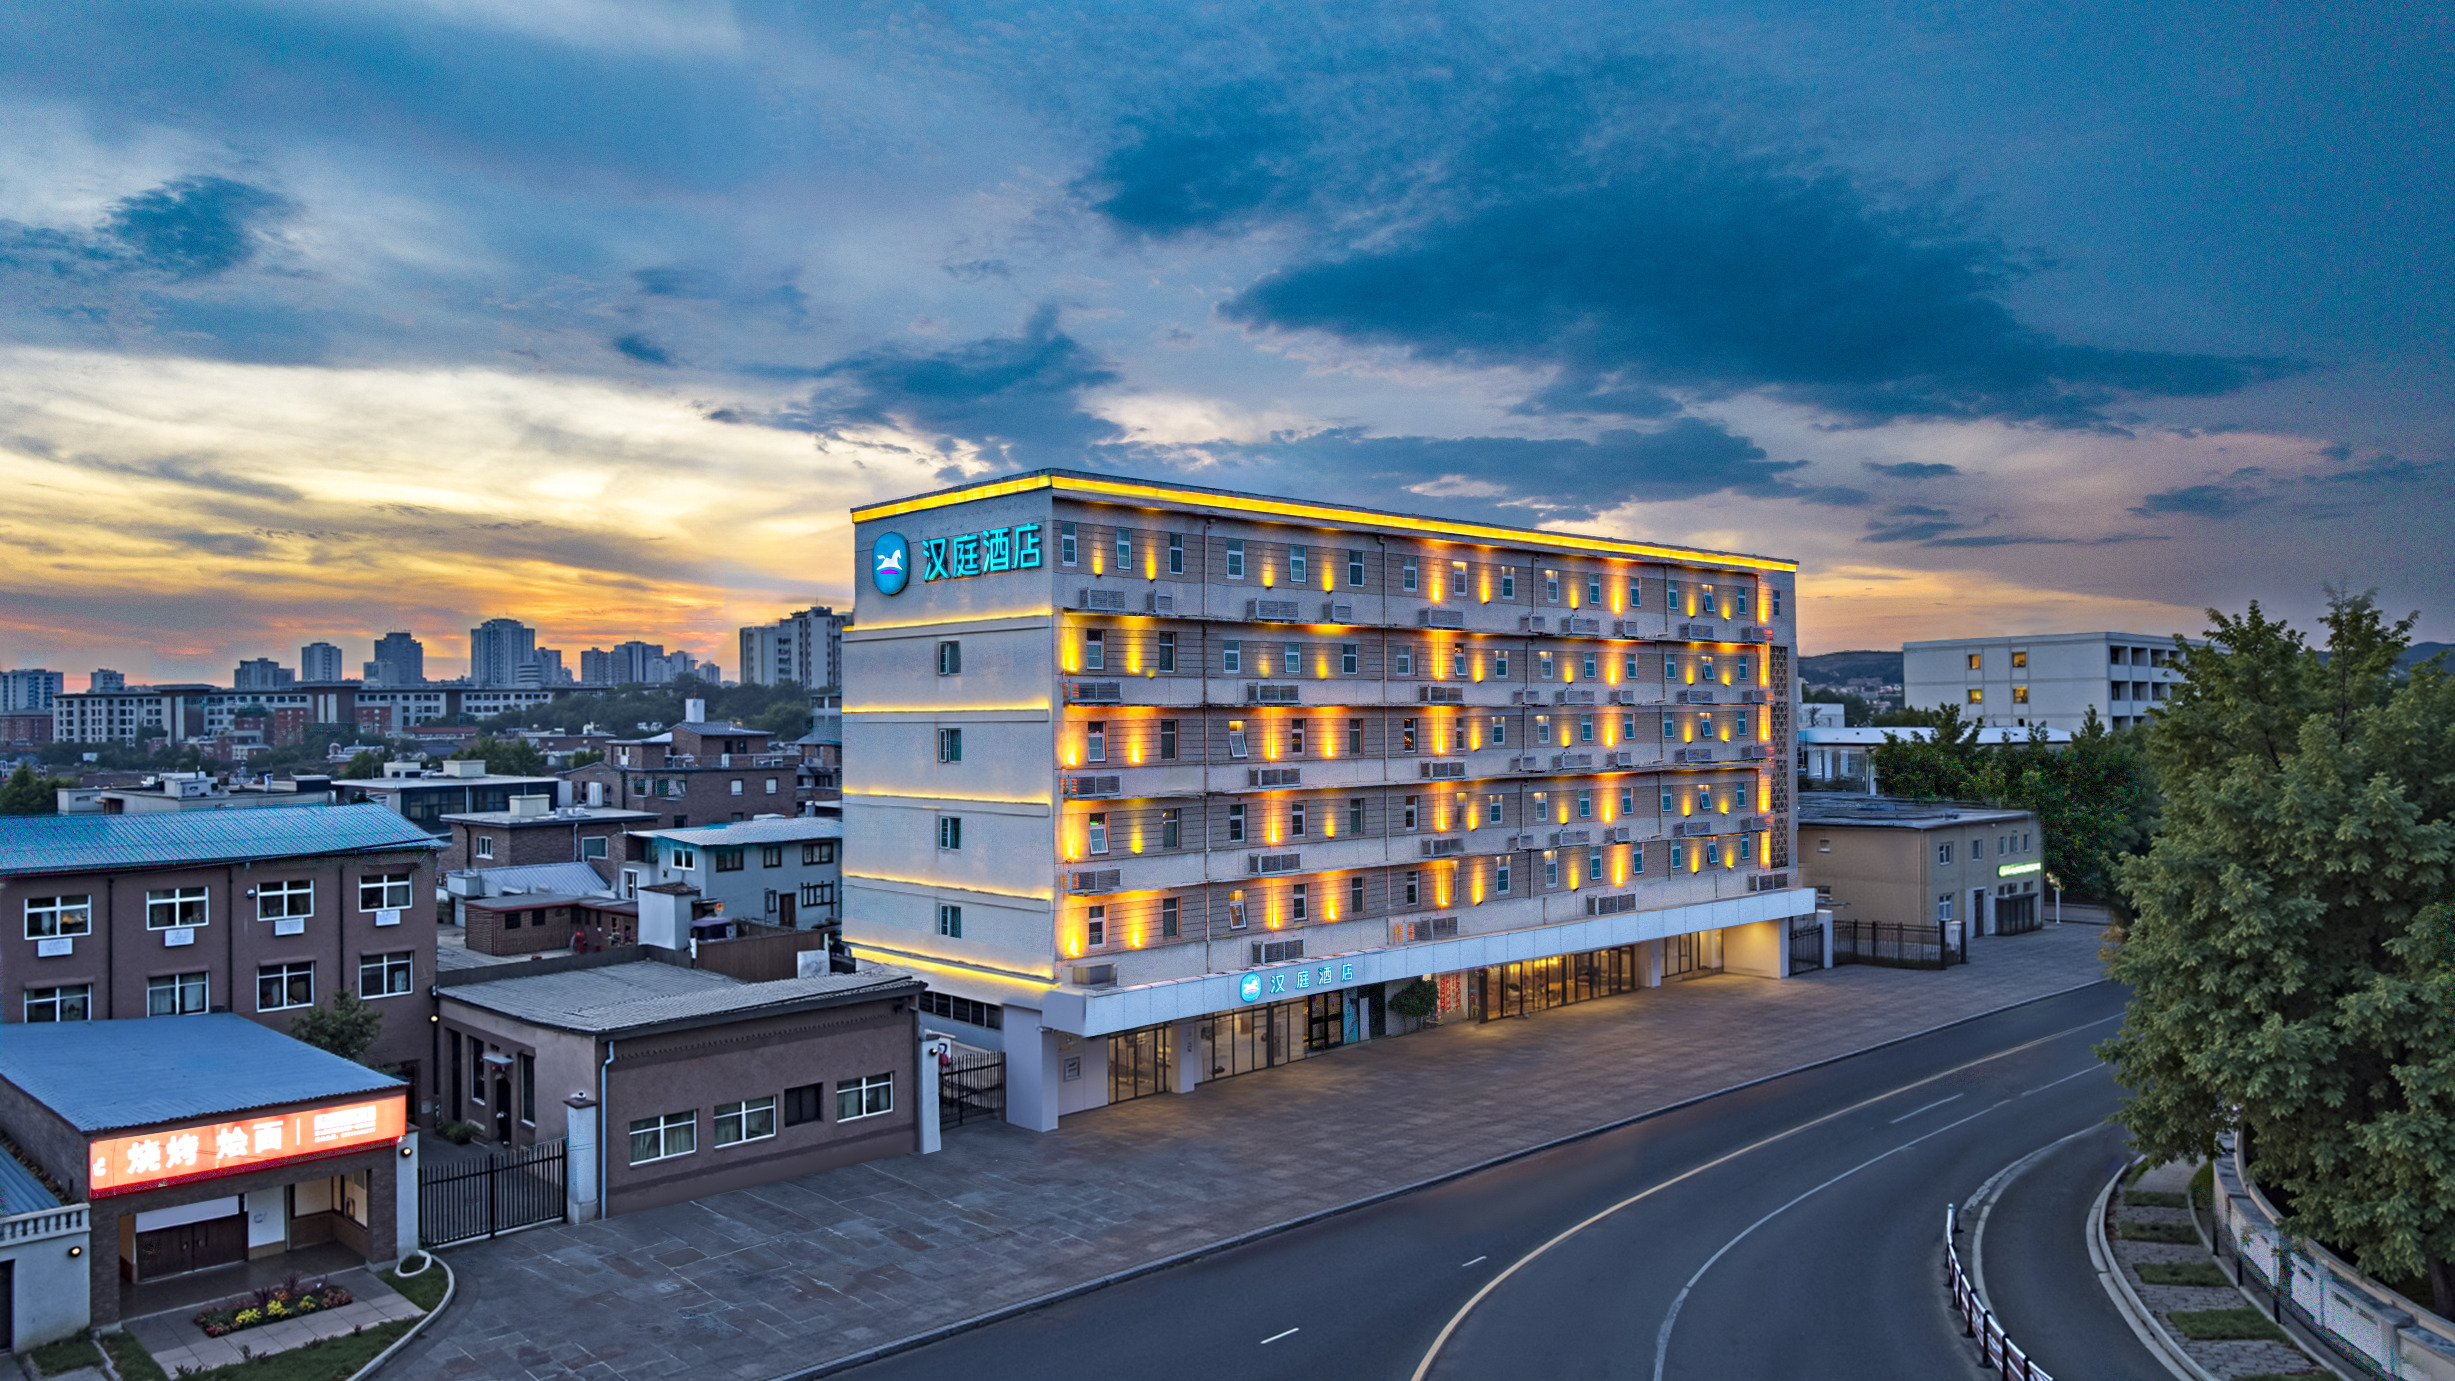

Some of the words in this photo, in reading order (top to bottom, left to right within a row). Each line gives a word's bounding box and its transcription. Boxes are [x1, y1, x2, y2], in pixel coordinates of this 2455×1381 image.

[922, 522, 1042, 581] 汉庭酒店
[1270, 963, 1354, 993] 汉庭酒店
[127, 1133, 199, 1174] 烧烤
[216, 1120, 284, 1160] 烩面
